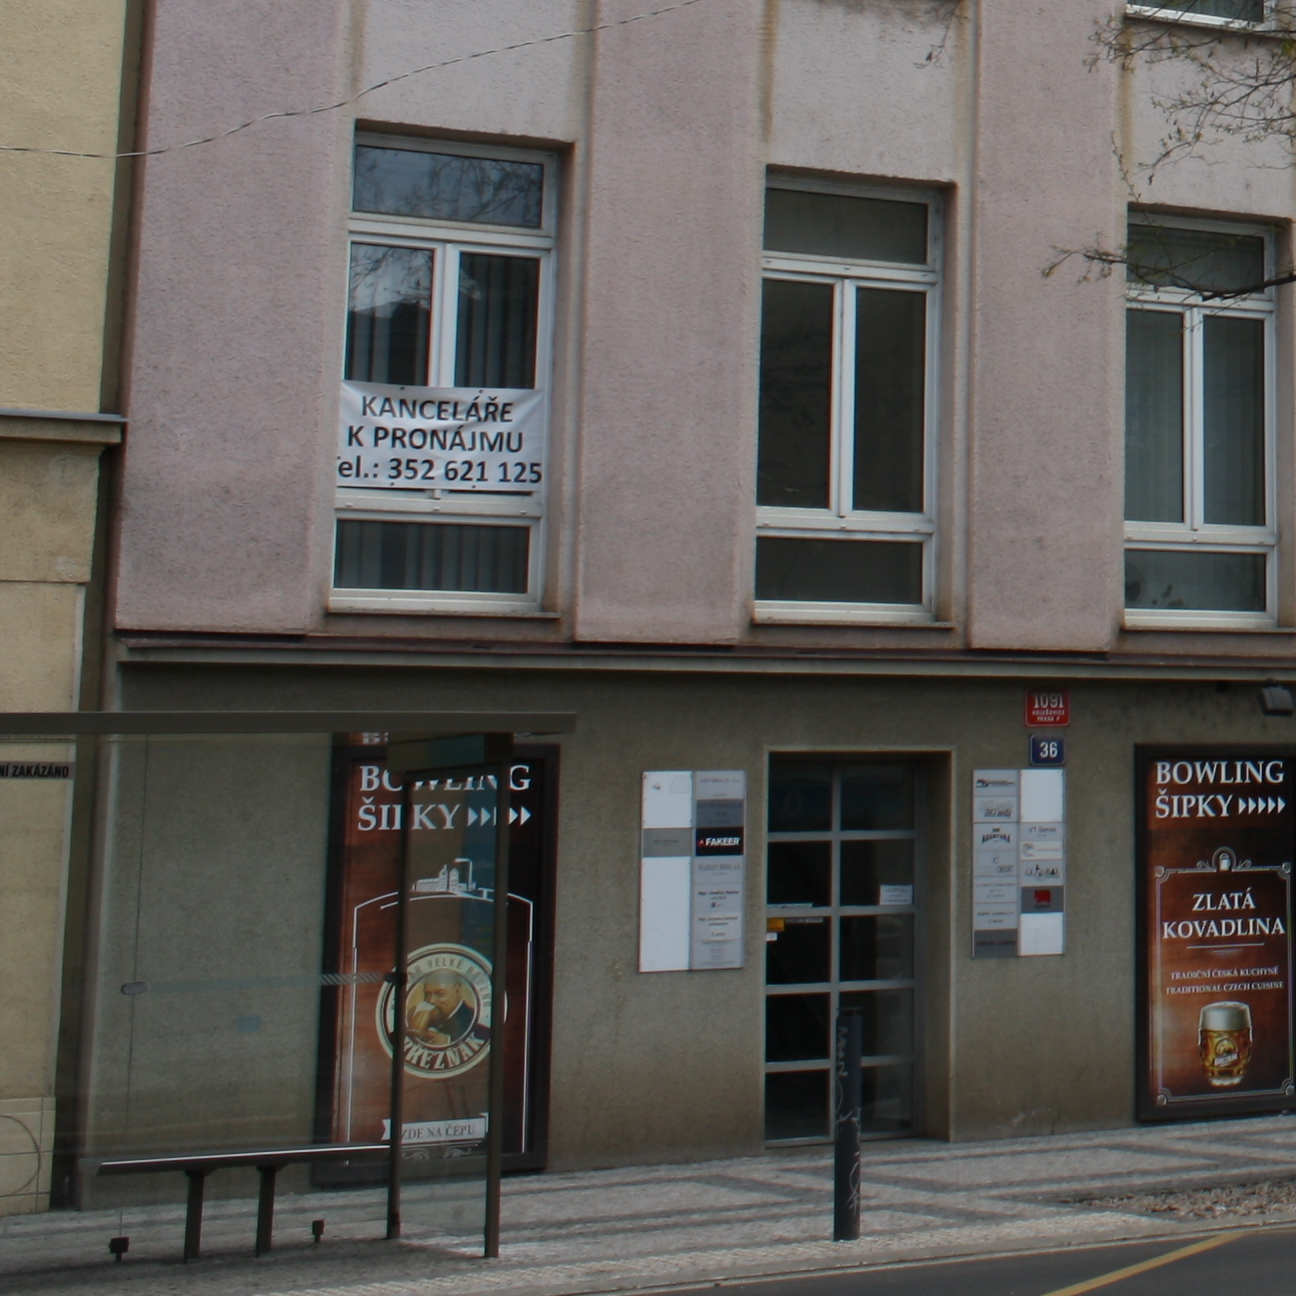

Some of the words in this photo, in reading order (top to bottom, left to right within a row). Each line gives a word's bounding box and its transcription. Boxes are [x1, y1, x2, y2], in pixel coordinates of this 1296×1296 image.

[361, 395, 514, 423] KANCELÁŘE
[347, 425, 364, 447] K
[373, 425, 523, 453] PRONÁJMU
[337, 456, 379, 479] el.:
[388, 457, 436, 481] 352
[444, 460, 489, 482] 621
[498, 461, 542, 484] 125
[1034, 692, 1064, 709] 1091
[1040, 741, 1058, 758] 36
[1155, 760, 1285, 785] BOWLING
[1155, 788, 1234, 819] ŠIPKY
[1192, 886, 1256, 912] ZLATÁ
[1162, 917, 1286, 939] KOVADLINA
[1171, 968, 1211, 980] TRADIČNÍ
[1212, 966, 1238, 978] ČESKÁ
[1165, 984, 1222, 995] TRADITIONAL
[1223, 982, 1250, 992] CZECH
[1251, 981, 1284, 990] CUISINE
[427, 1127, 442, 1137] NA
[445, 1124, 475, 1137] ČEPU
